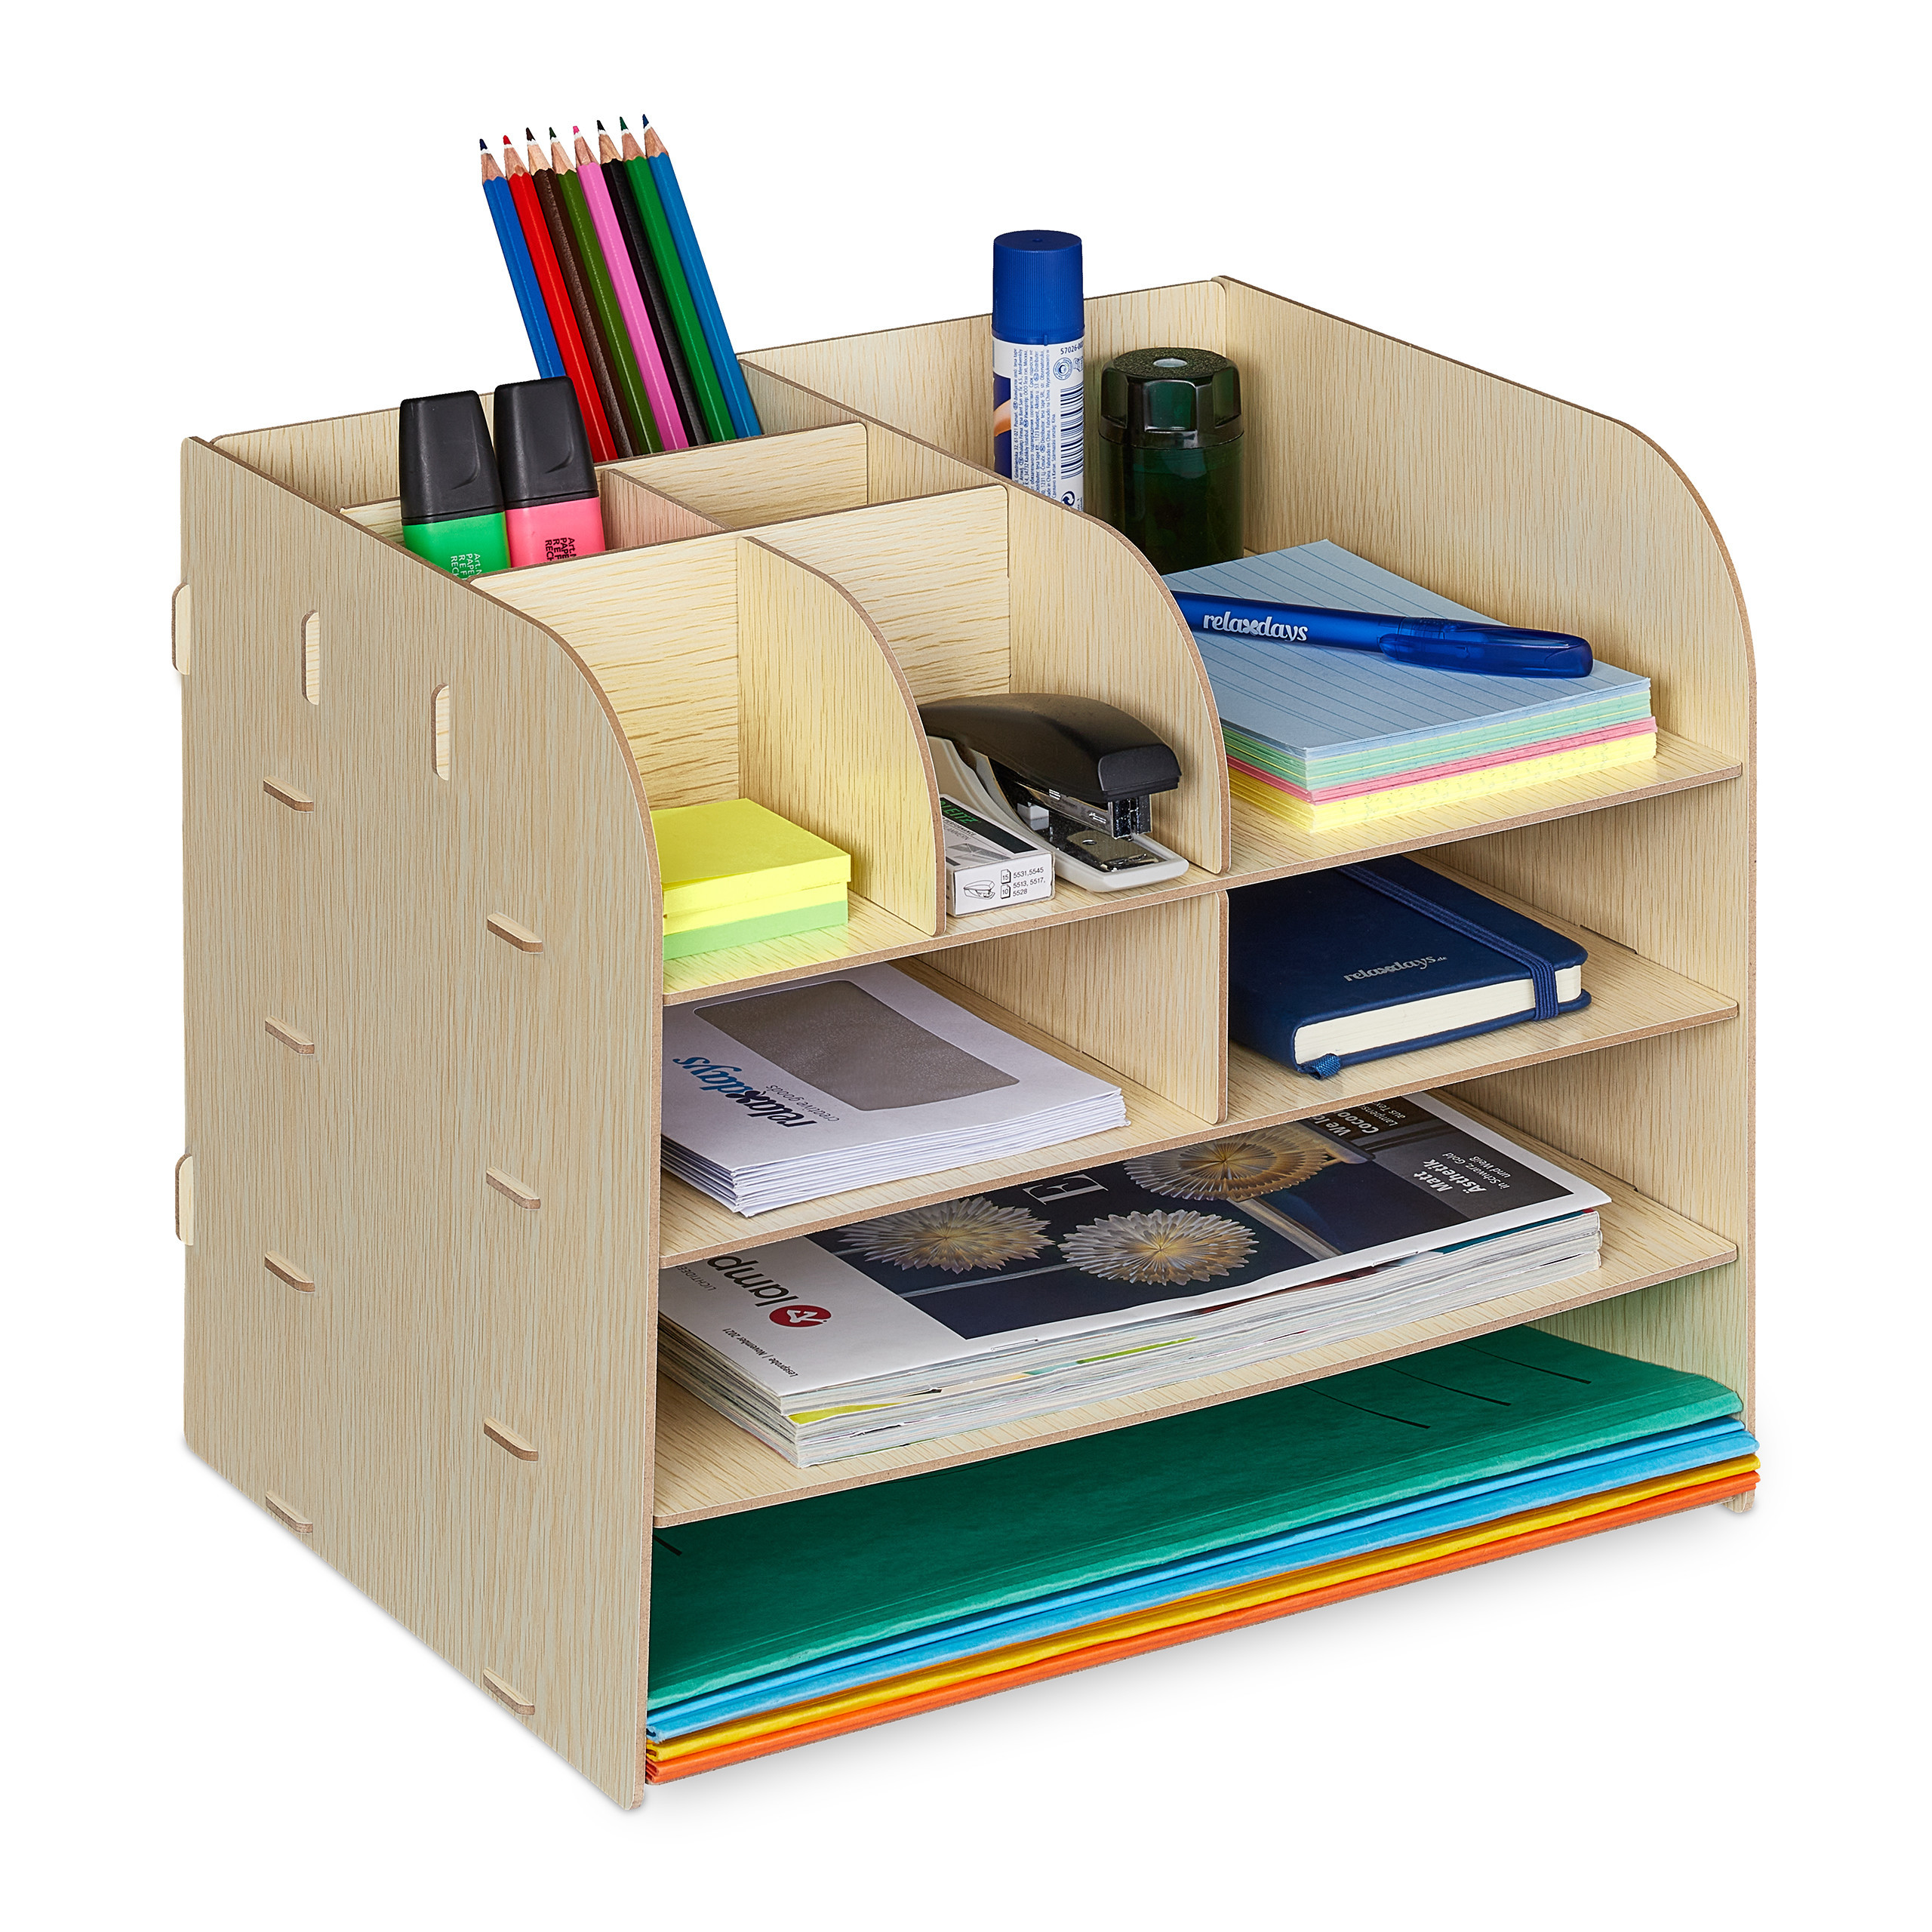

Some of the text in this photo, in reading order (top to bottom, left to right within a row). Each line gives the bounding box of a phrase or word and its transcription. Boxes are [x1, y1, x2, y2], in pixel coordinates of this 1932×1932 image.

[560, 537, 568, 559] PAPE
[466, 553, 475, 575] PAPE
[1203, 611, 1309, 641] relaxdays
[1013, 876, 1046, 889] 5513, 5517,
[1013, 888, 1028, 897] 5528
[672, 1056, 818, 1128] relaxdays
[766, 1084, 840, 1121] creative goods
[1358, 1105, 1398, 1127] Lampens
[1373, 1102, 1390, 1112] Tex
[1325, 1121, 1352, 1137] We
[1334, 1111, 1380, 1134] Cocoo
[1441, 1152, 1466, 1164] Gold
[1469, 1155, 1512, 1178] und Weiß
[1413, 1171, 1454, 1192] Matt
[1423, 1158, 1487, 1194] Ästhetik
[675, 1266, 717, 1291] LICHTIDEE
[706, 1255, 800, 1308] lamp
[722, 1327, 741, 1338] 2021
[736, 1337, 768, 1356] November
